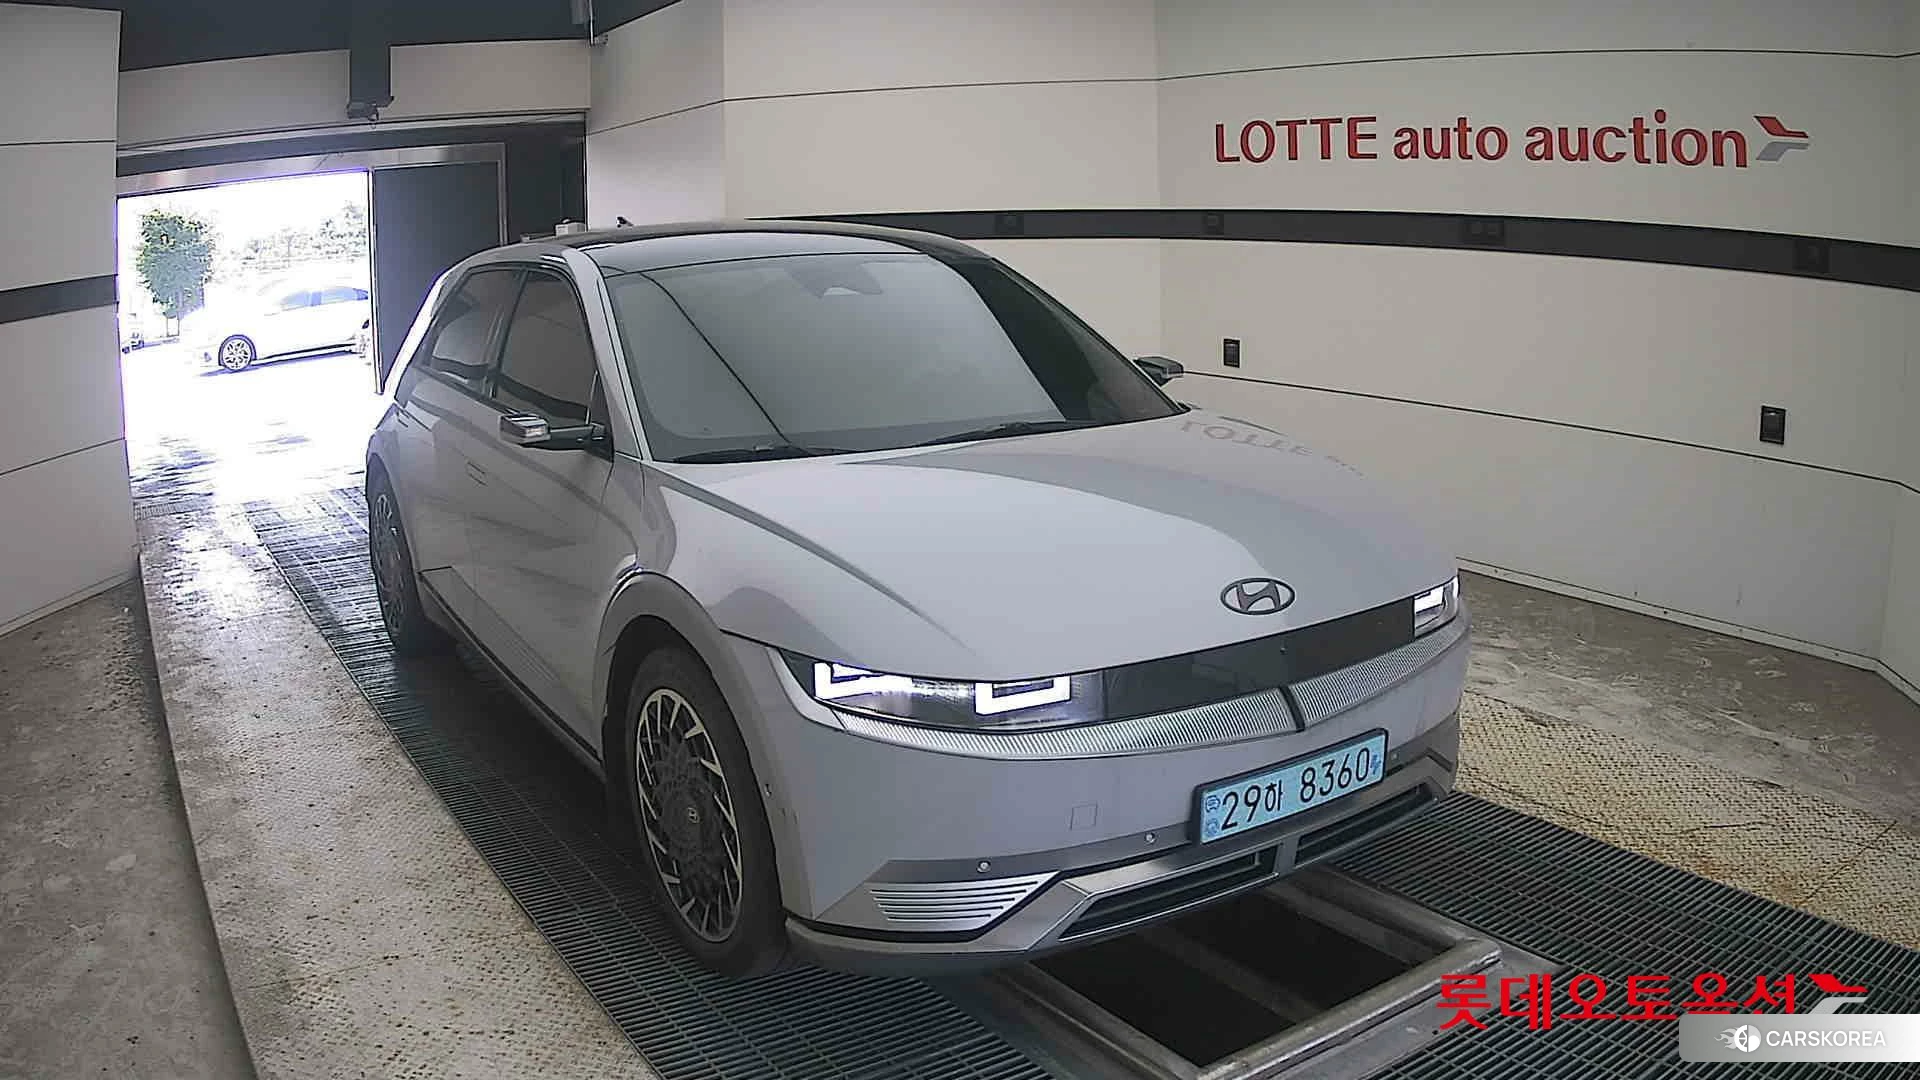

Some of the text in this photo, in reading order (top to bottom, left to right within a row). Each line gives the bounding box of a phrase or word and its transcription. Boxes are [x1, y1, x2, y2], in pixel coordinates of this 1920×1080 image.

[1215, 109, 1748, 168] LOTTE auto auction
[1221, 747, 1370, 830] 29하 8360
